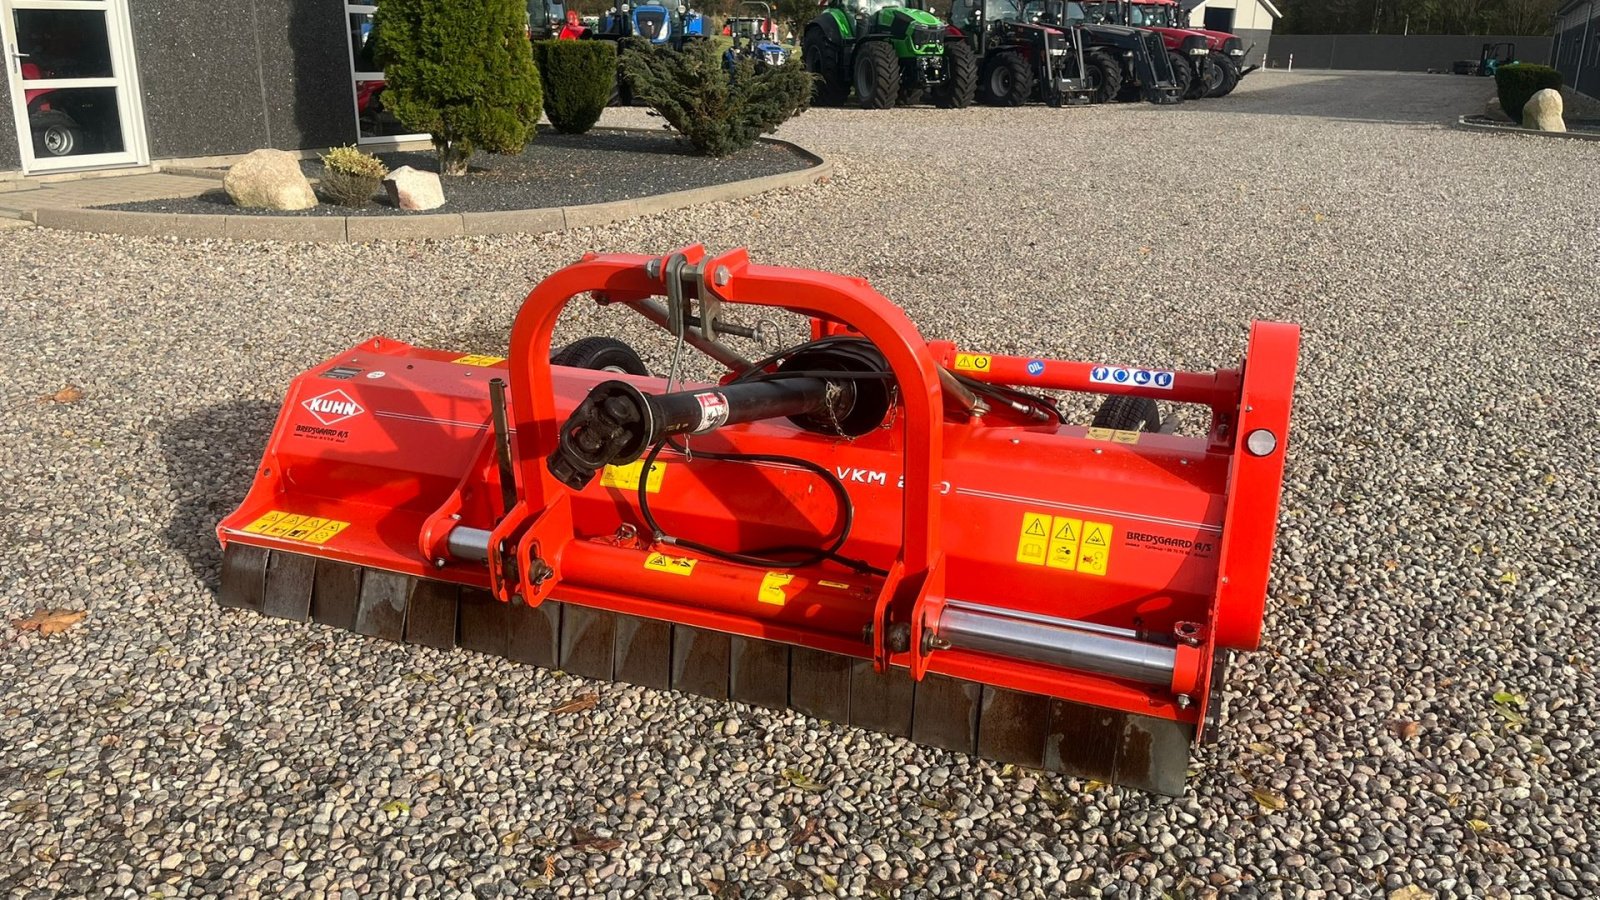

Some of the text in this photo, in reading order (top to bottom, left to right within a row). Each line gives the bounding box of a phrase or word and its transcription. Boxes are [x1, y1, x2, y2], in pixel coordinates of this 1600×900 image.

[1028, 362, 1043, 374] OIL
[310, 399, 356, 415] KUHN
[296, 425, 337, 436] BREDSGAARD
[337, 430, 349, 438] A/S
[836, 466, 886, 485] VKM
[1126, 531, 1192, 548] BREDSGAARD
[1194, 542, 1213, 552] A/S
